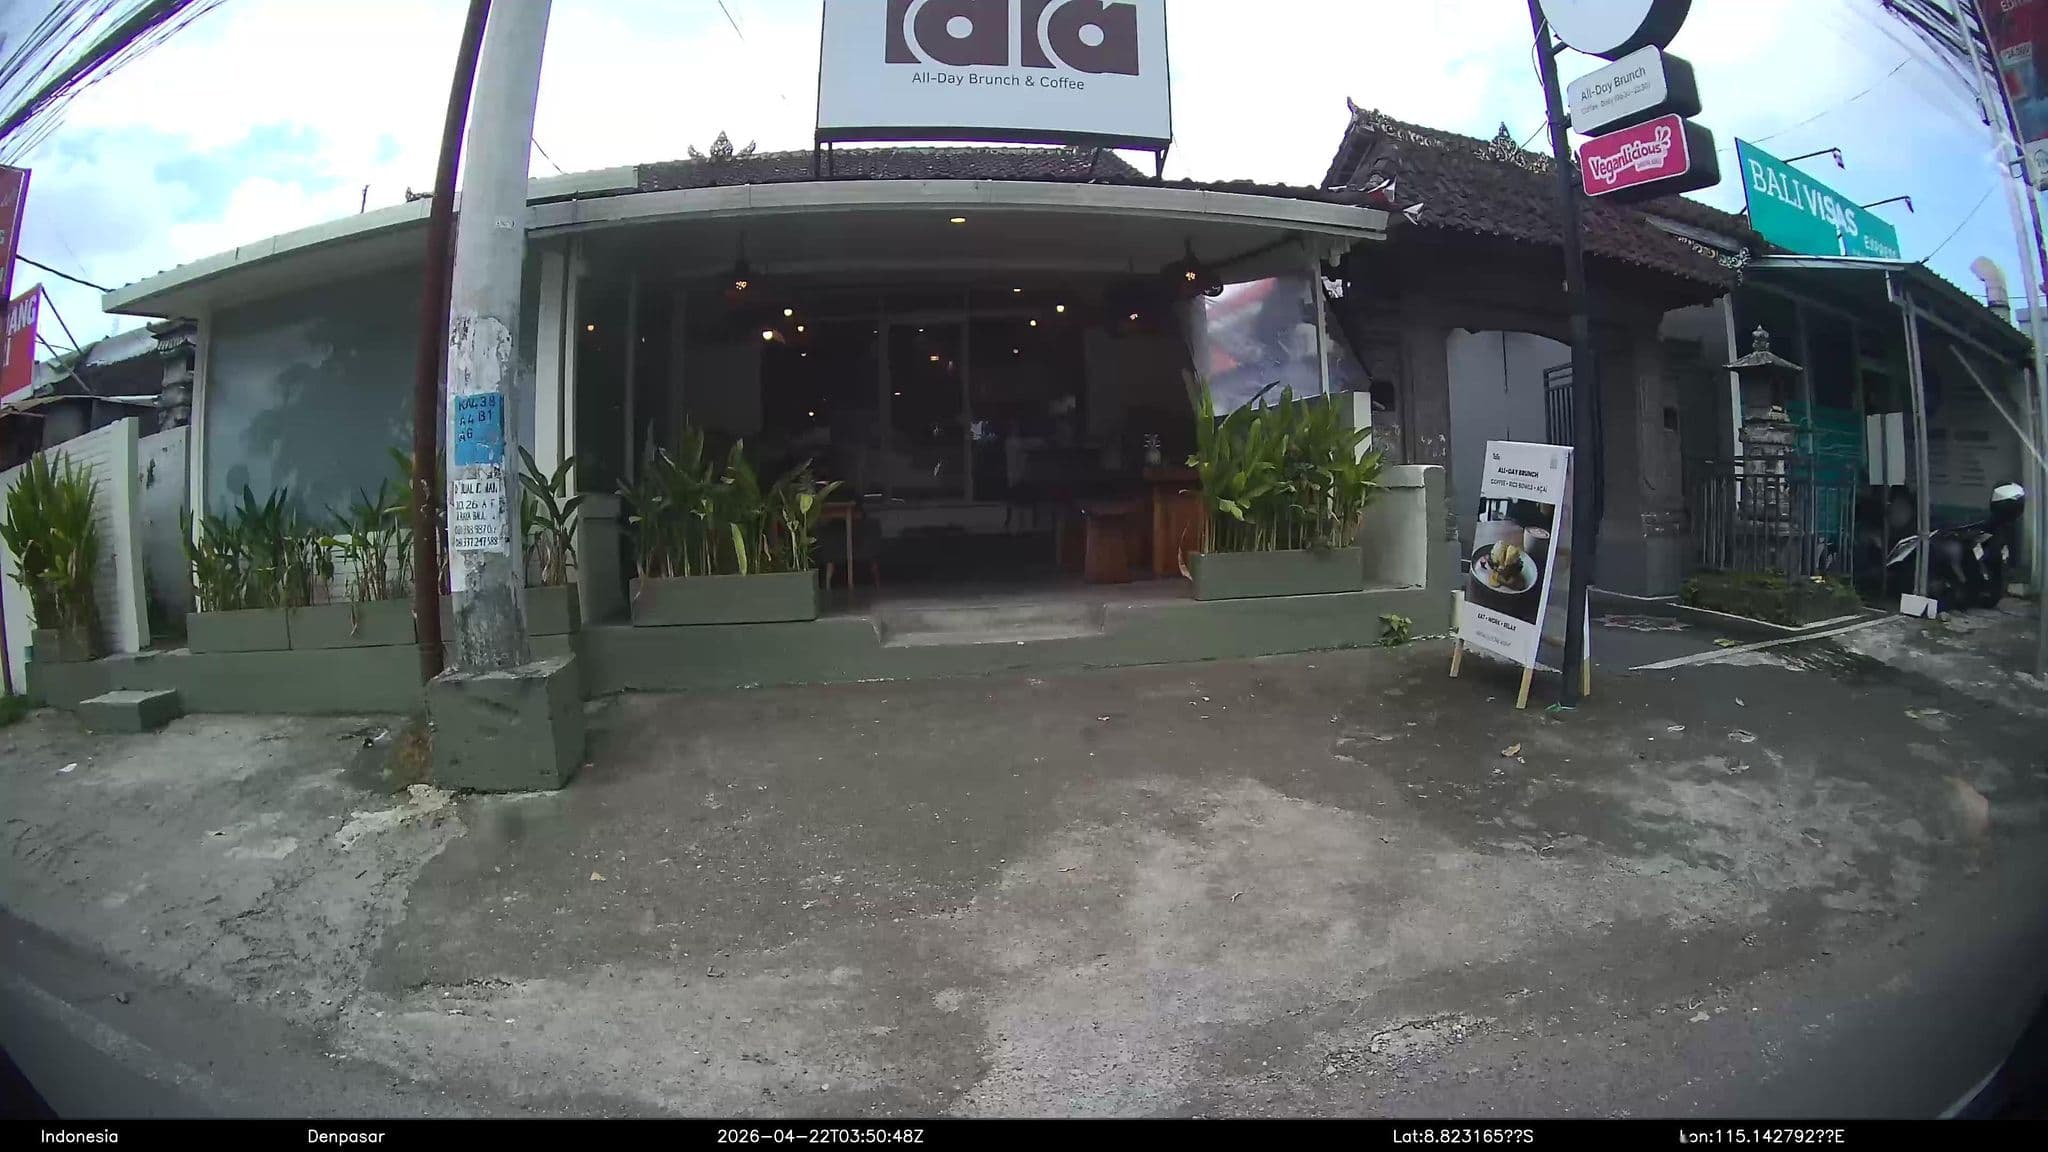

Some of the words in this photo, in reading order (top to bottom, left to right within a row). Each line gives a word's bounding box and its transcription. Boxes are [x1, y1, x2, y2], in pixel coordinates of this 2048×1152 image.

[912, 71, 964, 86] All-Day
[969, 73, 1020, 87] Brunch
[1025, 75, 1035, 87] &
[1040, 76, 1085, 91] Coffee
[1581, 80, 1613, 101] All-Day
[1614, 66, 1646, 87] Brunch
[1591, 143, 1661, 180] Veganlicious
[1748, 159, 1804, 210] BALI
[1804, 184, 1858, 236] VISAS
[1519, 470, 1539, 478] BRUNCH
